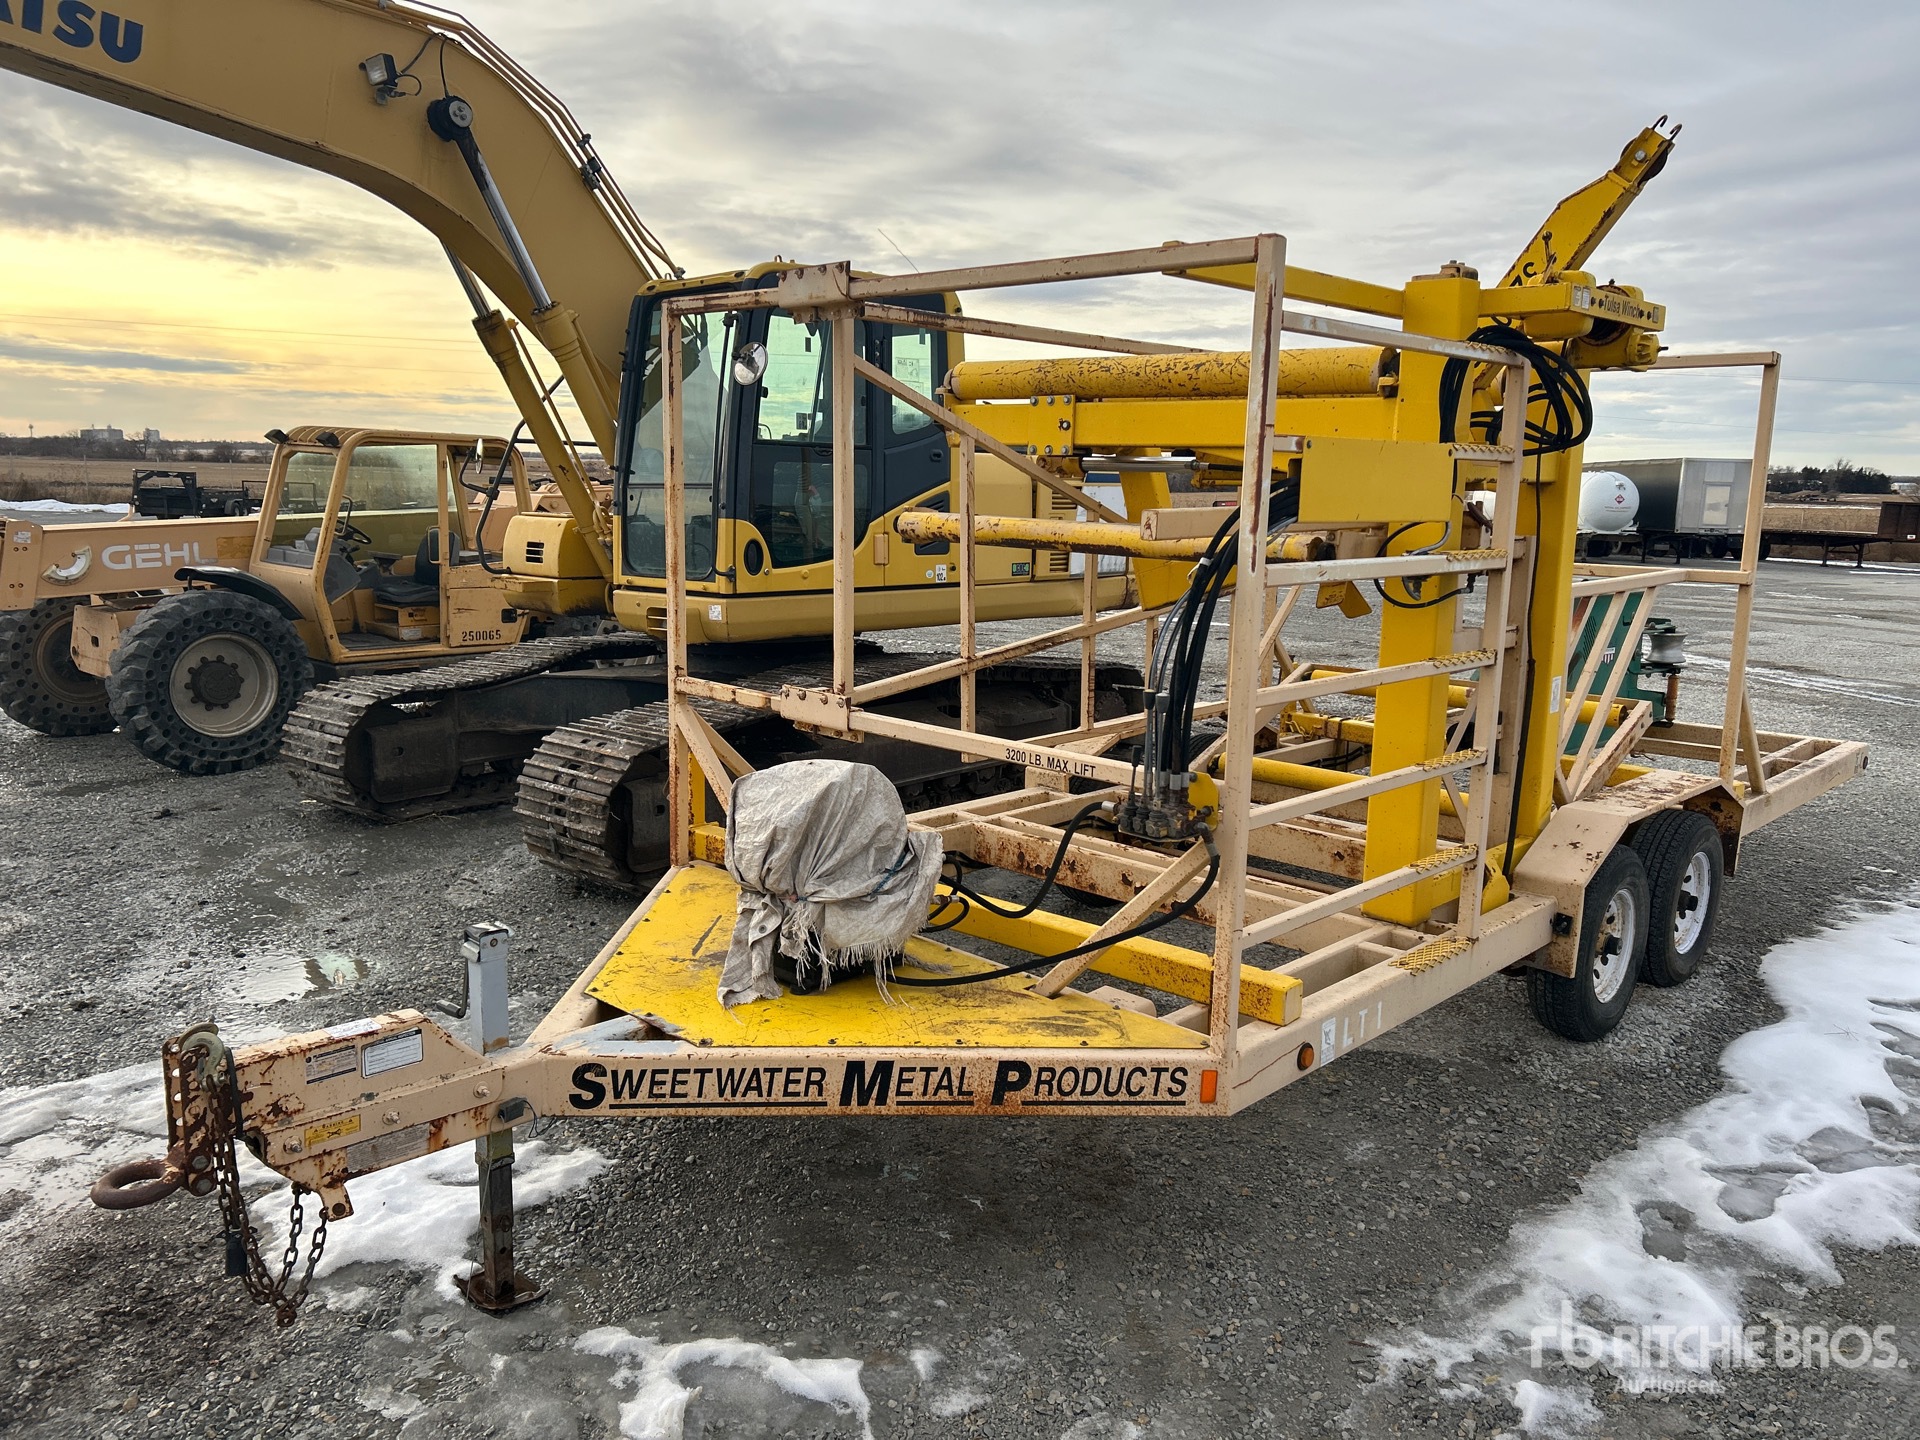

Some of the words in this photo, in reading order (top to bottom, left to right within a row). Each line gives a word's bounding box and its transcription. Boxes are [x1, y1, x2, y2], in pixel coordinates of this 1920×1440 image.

[1603, 294, 1620, 312] Tulsa
[1621, 299, 1641, 320] Winch
[101, 541, 218, 570] GEHL
[461, 629, 502, 642] 250065
[1005, 748, 1026, 763] 3200
[1029, 753, 1044, 767] LB.
[1047, 756, 1071, 773] MAX.
[1074, 762, 1096, 778] LIFT
[568, 1062, 827, 1110] SWEETWATER
[838, 1060, 975, 1107] METAL
[990, 1060, 1189, 1106] PRODUCTS
